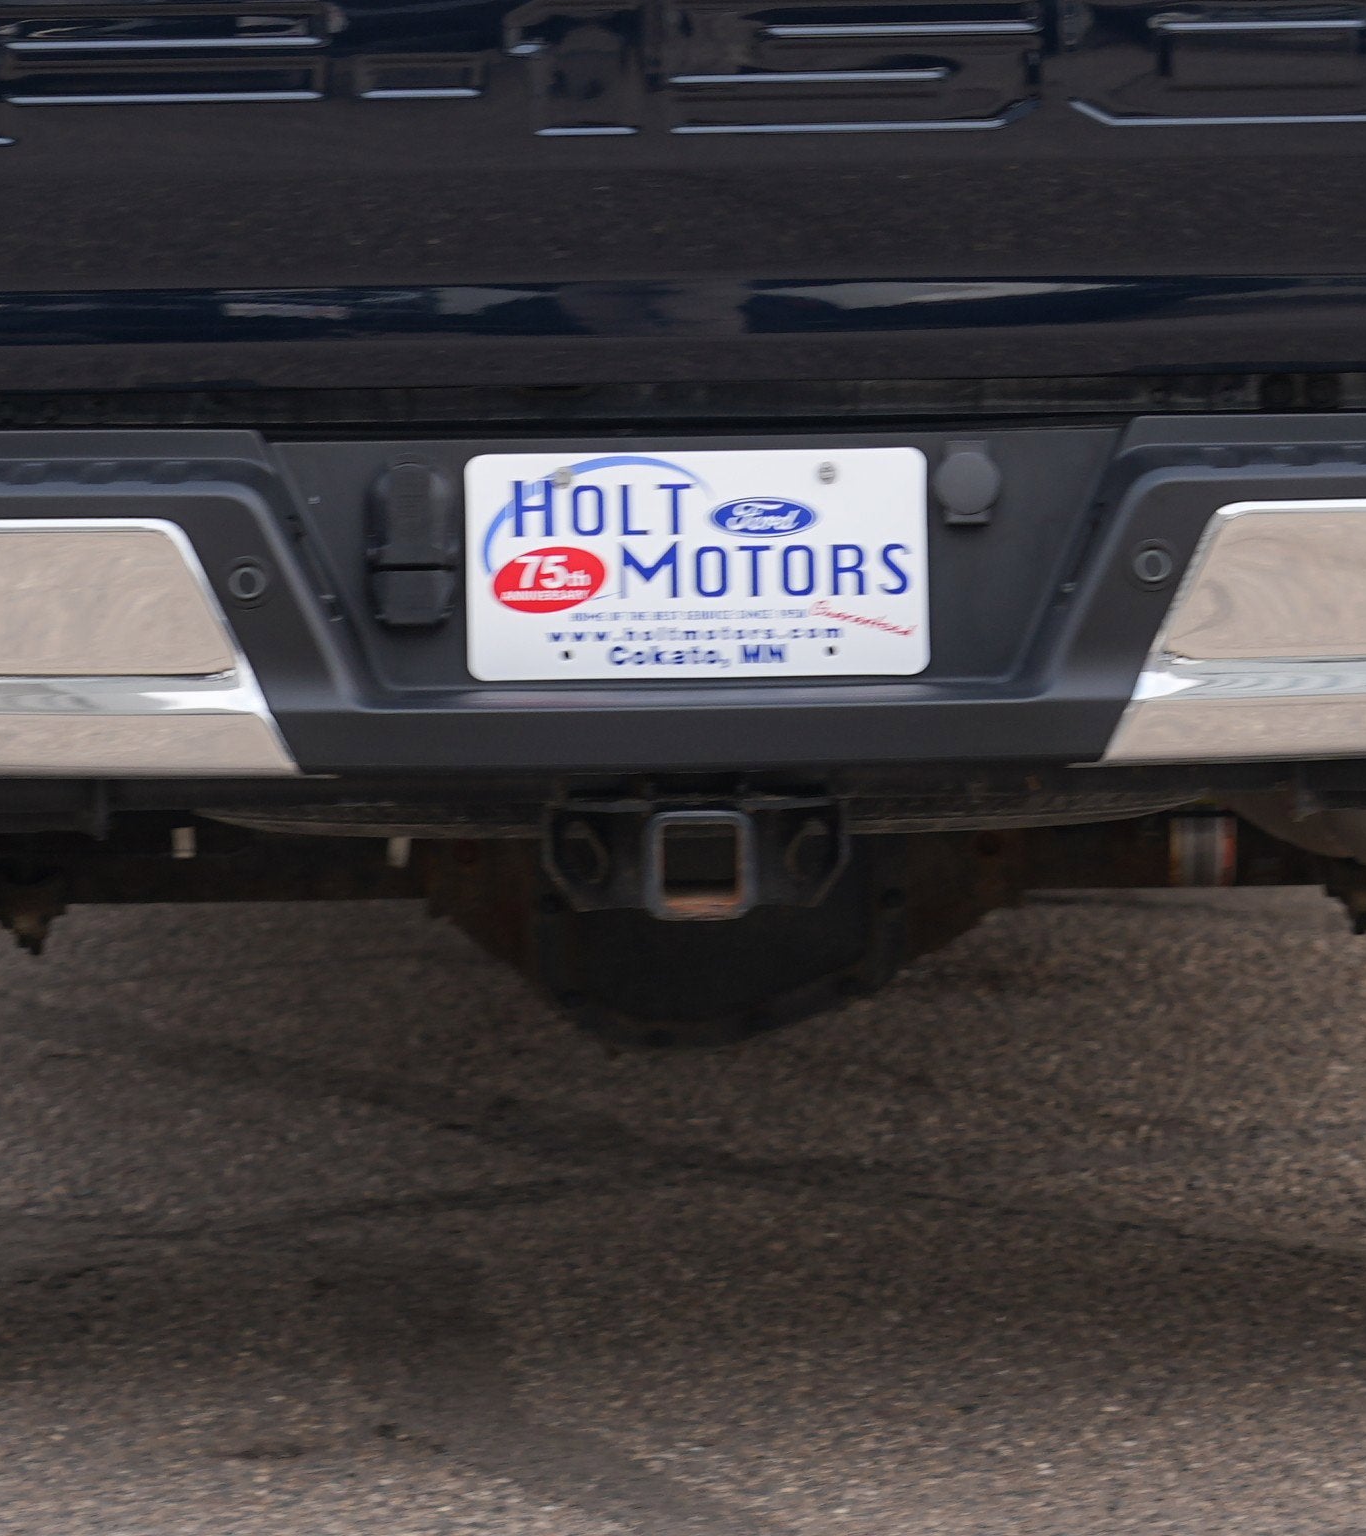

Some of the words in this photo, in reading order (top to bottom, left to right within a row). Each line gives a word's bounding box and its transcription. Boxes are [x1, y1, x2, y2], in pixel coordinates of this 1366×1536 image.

[509, 479, 696, 538] HOLT
[724, 503, 802, 531] Ford
[514, 554, 592, 589] 75th
[619, 540, 912, 599] MOTORS
[546, 627, 844, 643] www.holtmotors.com
[608, 644, 731, 668] Cokato,
[739, 643, 788, 664] MN
